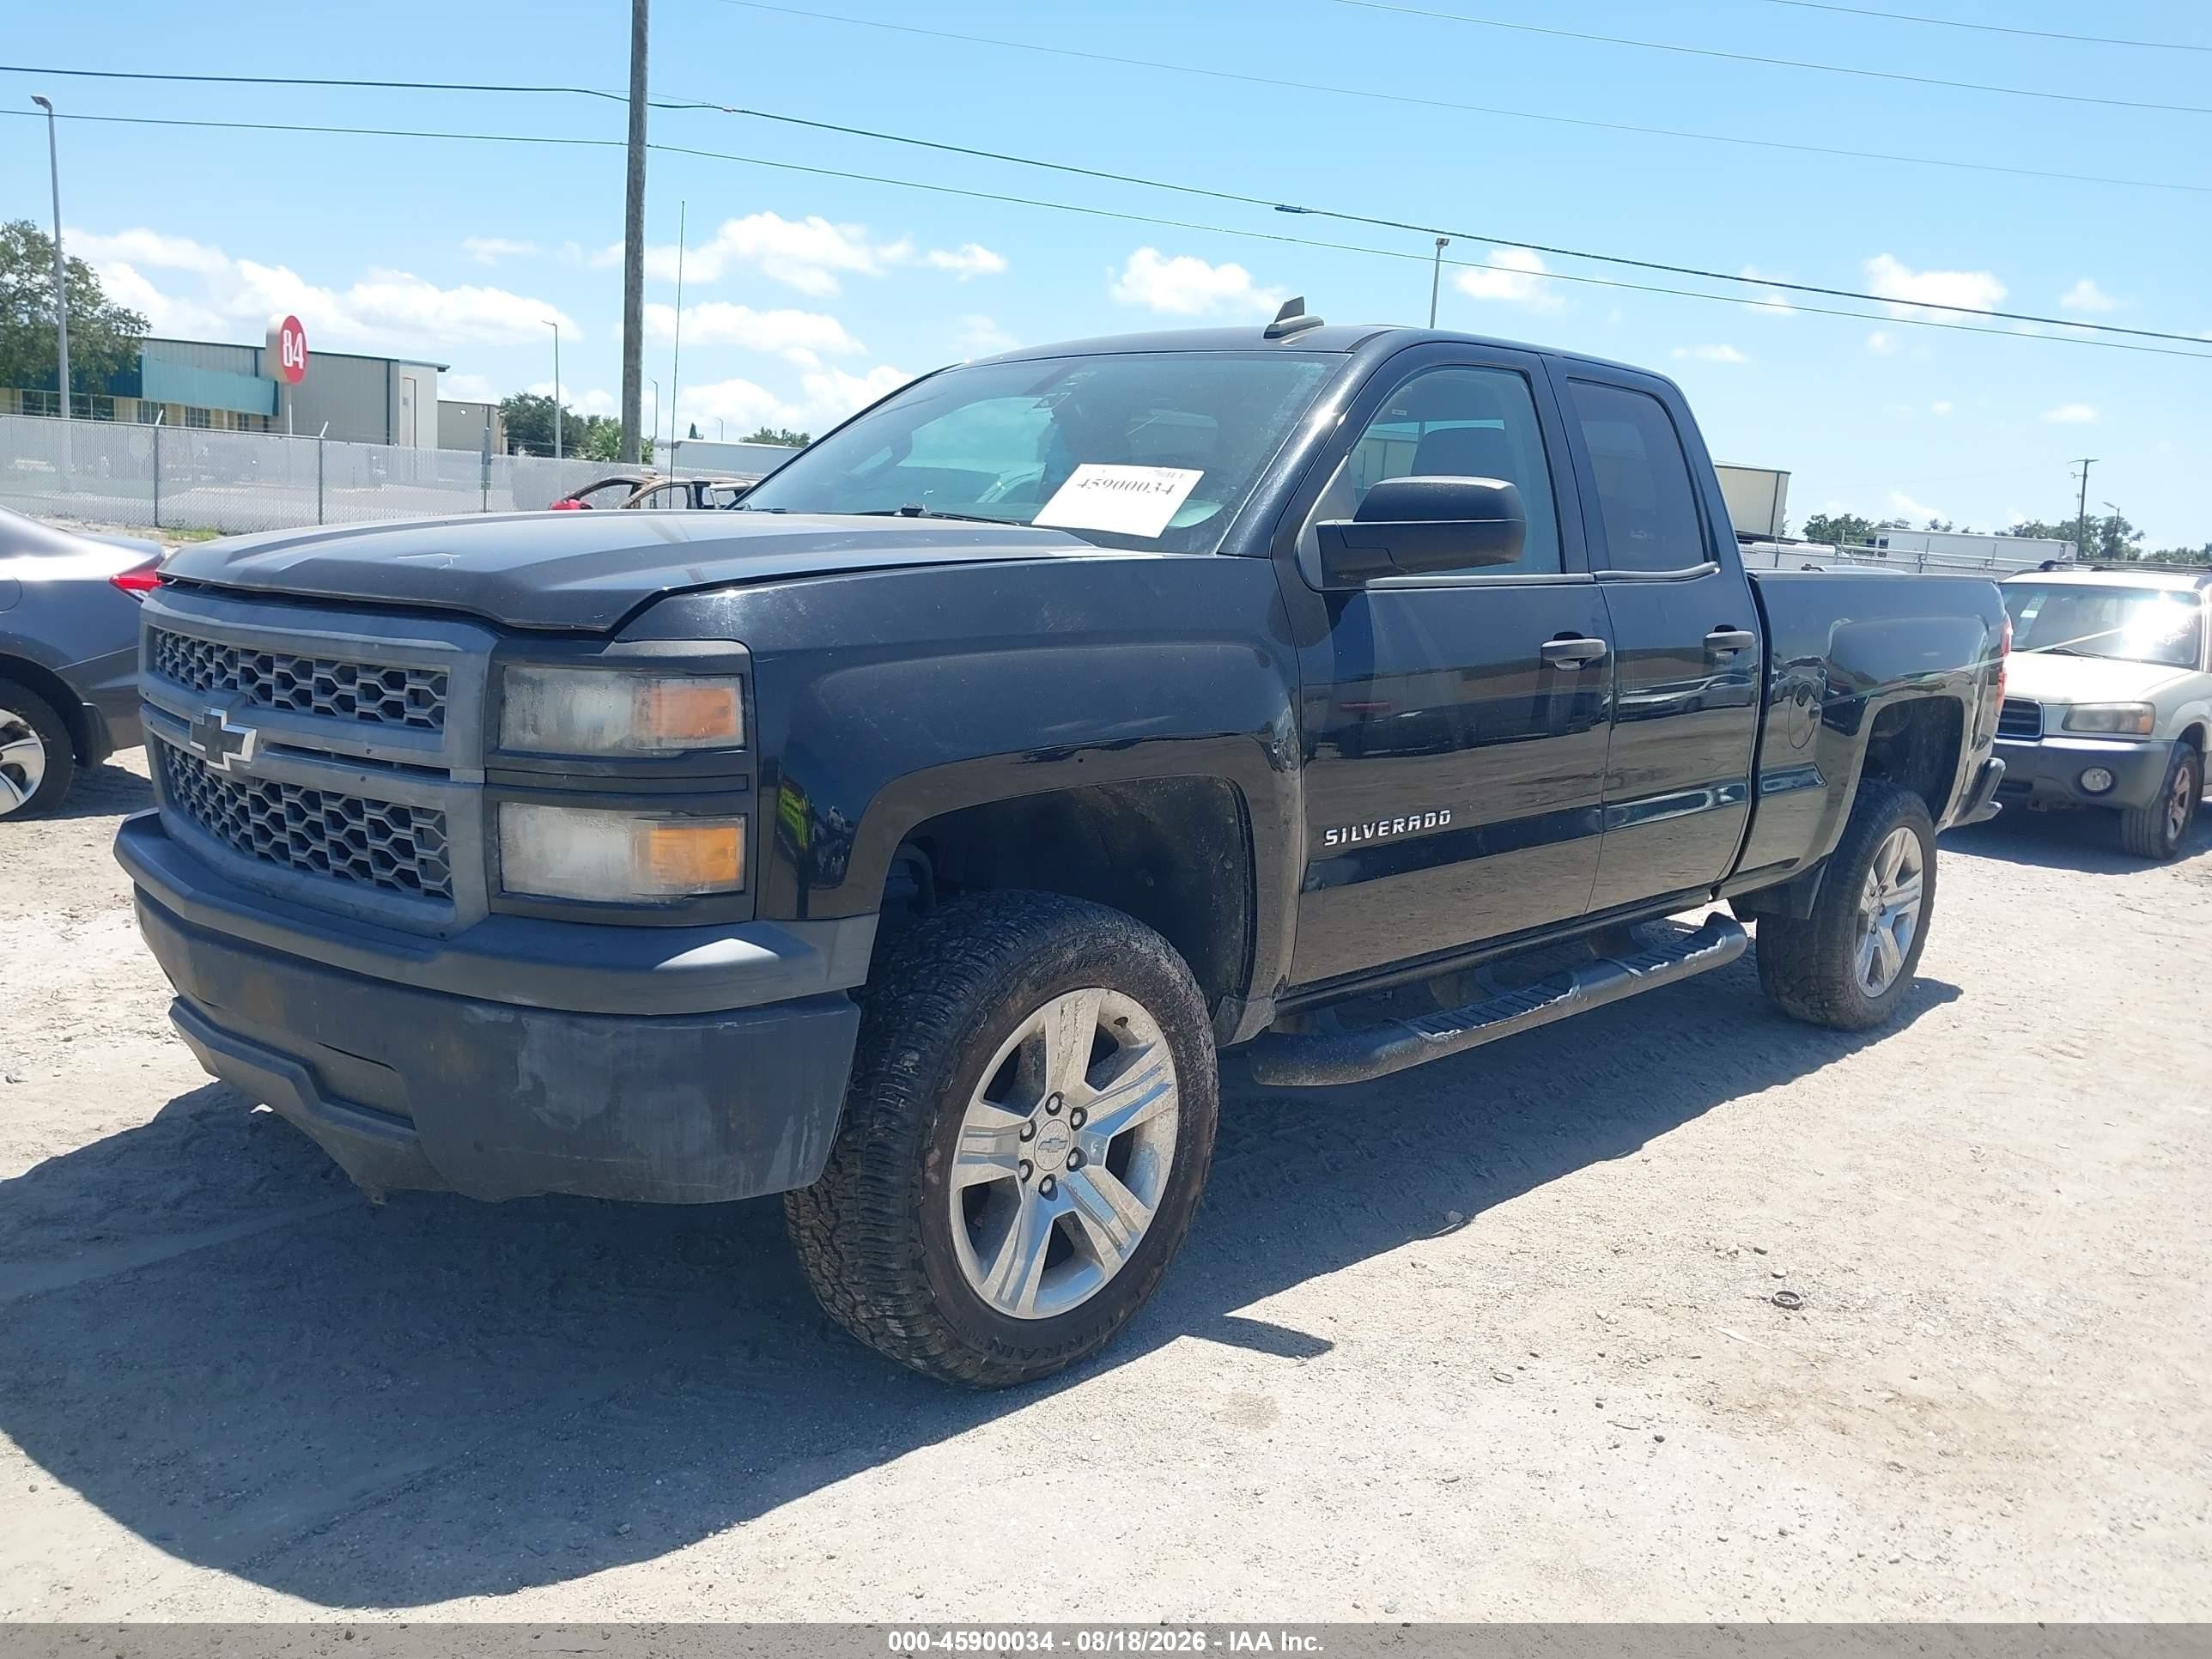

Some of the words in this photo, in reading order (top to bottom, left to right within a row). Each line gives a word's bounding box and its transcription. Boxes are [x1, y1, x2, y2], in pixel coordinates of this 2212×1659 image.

[283, 329, 305, 369] 84
[1078, 478, 1175, 495] 45900034
[1323, 809, 1453, 847] SILVERADO
